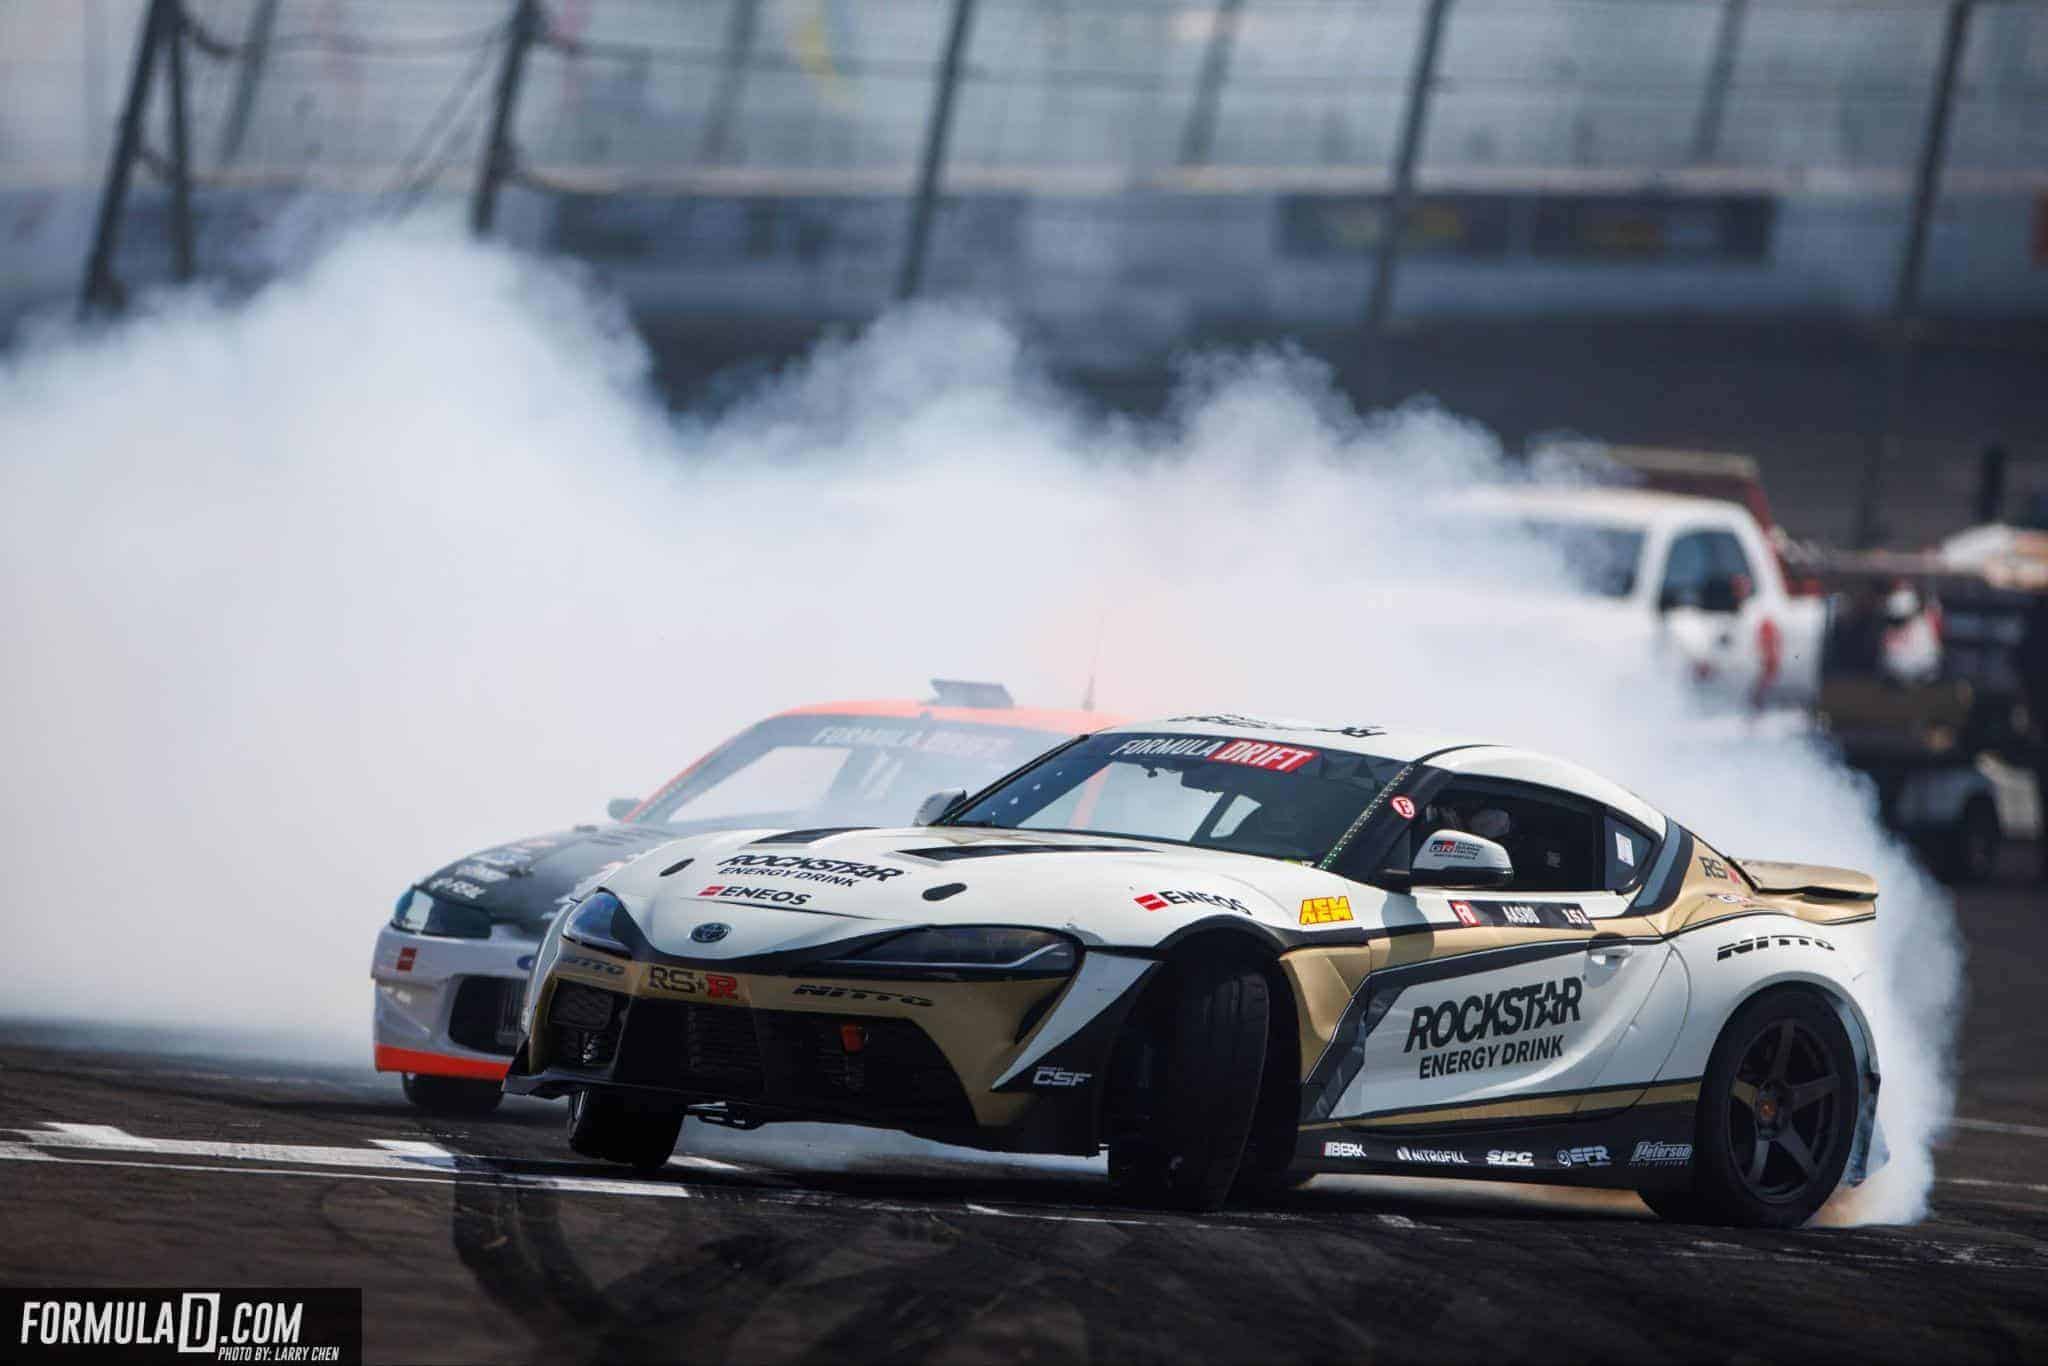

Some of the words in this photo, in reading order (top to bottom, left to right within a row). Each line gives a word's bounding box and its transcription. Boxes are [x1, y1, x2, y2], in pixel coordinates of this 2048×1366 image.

[1110, 738, 1224, 758] FORMULA
[1219, 740, 1314, 771] DRIFT
[716, 854, 904, 882] ROCKSTAR
[717, 866, 795, 880] ENERGY
[793, 872, 861, 888] DRINK
[719, 885, 812, 905] ENEOS
[1158, 890, 1253, 916] ENEOS
[1299, 895, 1354, 925] AEM
[1716, 934, 1836, 962] NITTO
[792, 984, 935, 1007] NITTO
[1403, 975, 1583, 1053] ROCKSTAR
[1418, 1044, 1500, 1079] ENERGY
[1500, 1034, 1565, 1066] DRINK
[1032, 1070, 1093, 1087] CSF
[1486, 1149, 1534, 1163] SPC
